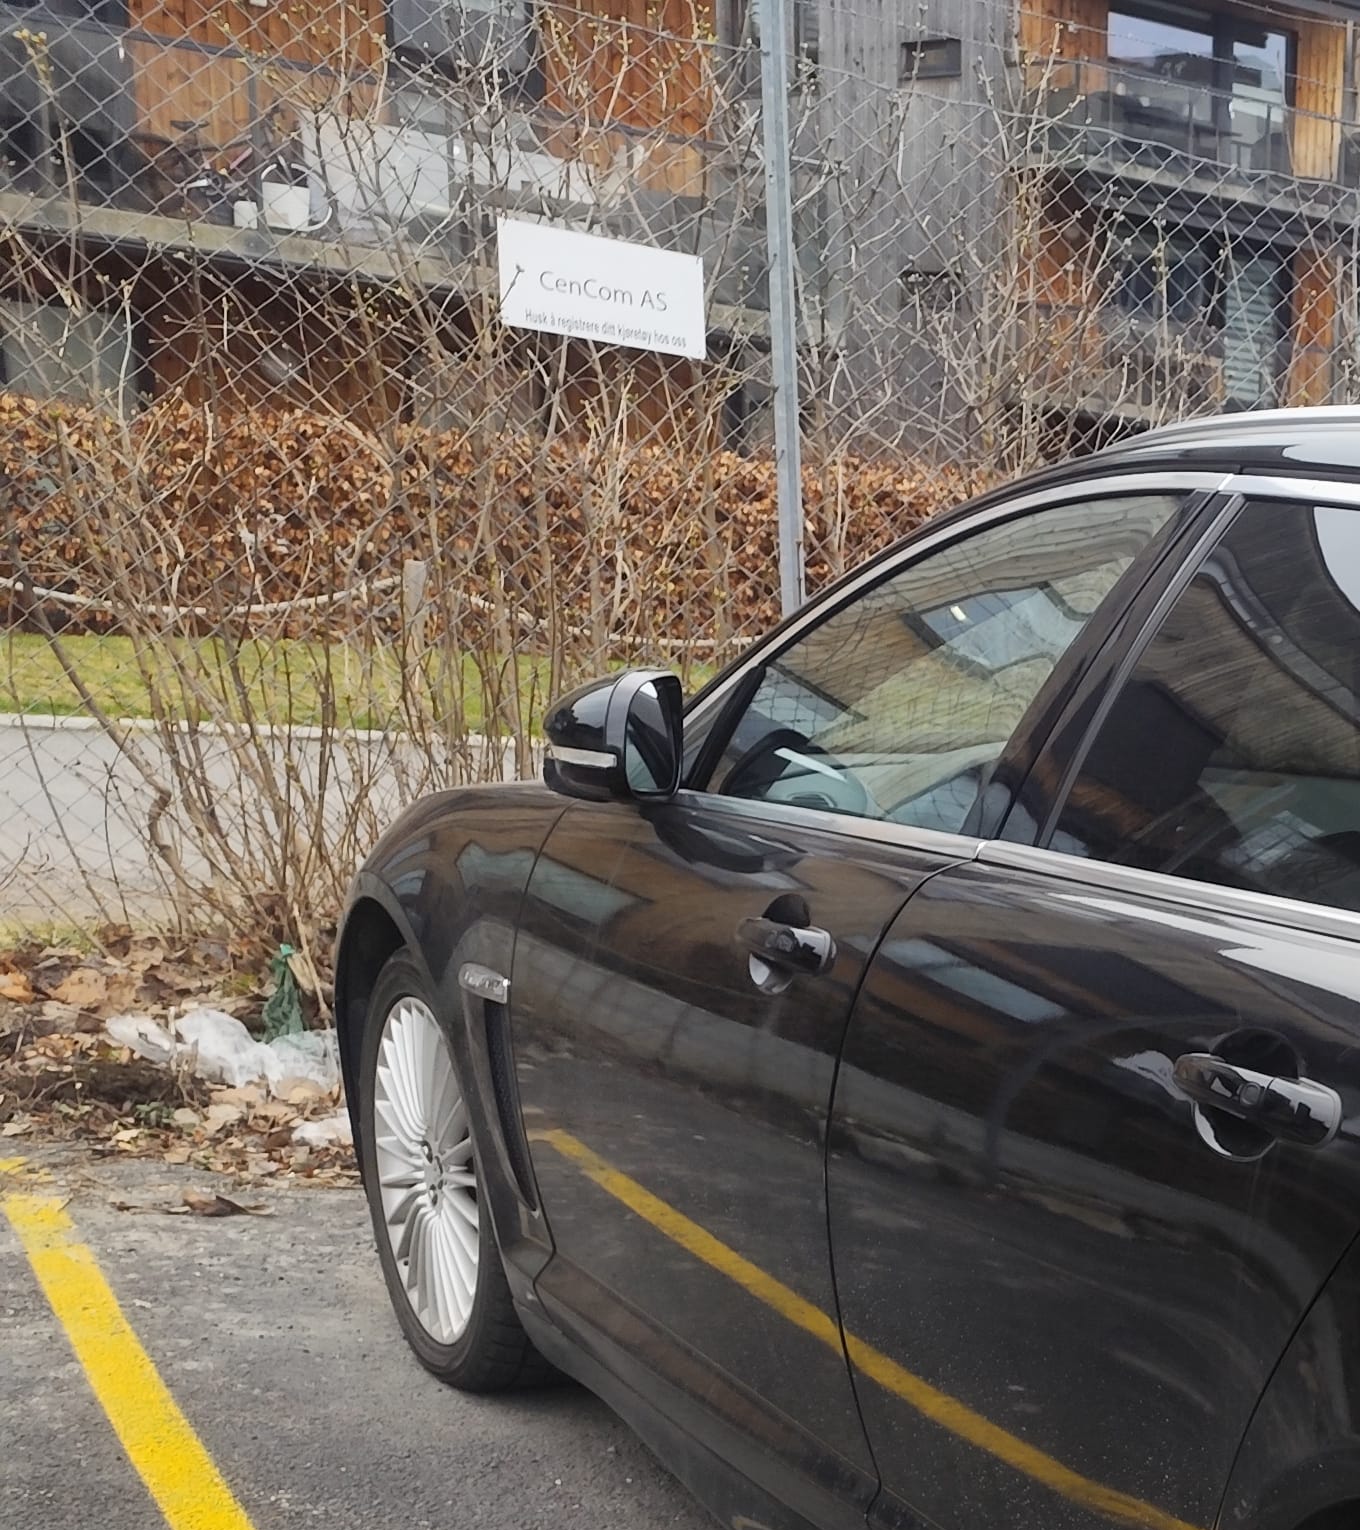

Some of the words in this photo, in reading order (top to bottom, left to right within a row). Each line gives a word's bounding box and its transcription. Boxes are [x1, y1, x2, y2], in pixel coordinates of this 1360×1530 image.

[539, 271, 633, 305] CenCom
[640, 289, 668, 311] AS
[525, 308, 547, 324] Husk
[557, 316, 599, 332] registrere
[653, 330, 669, 344] hos
[672, 336, 687, 348] oss
